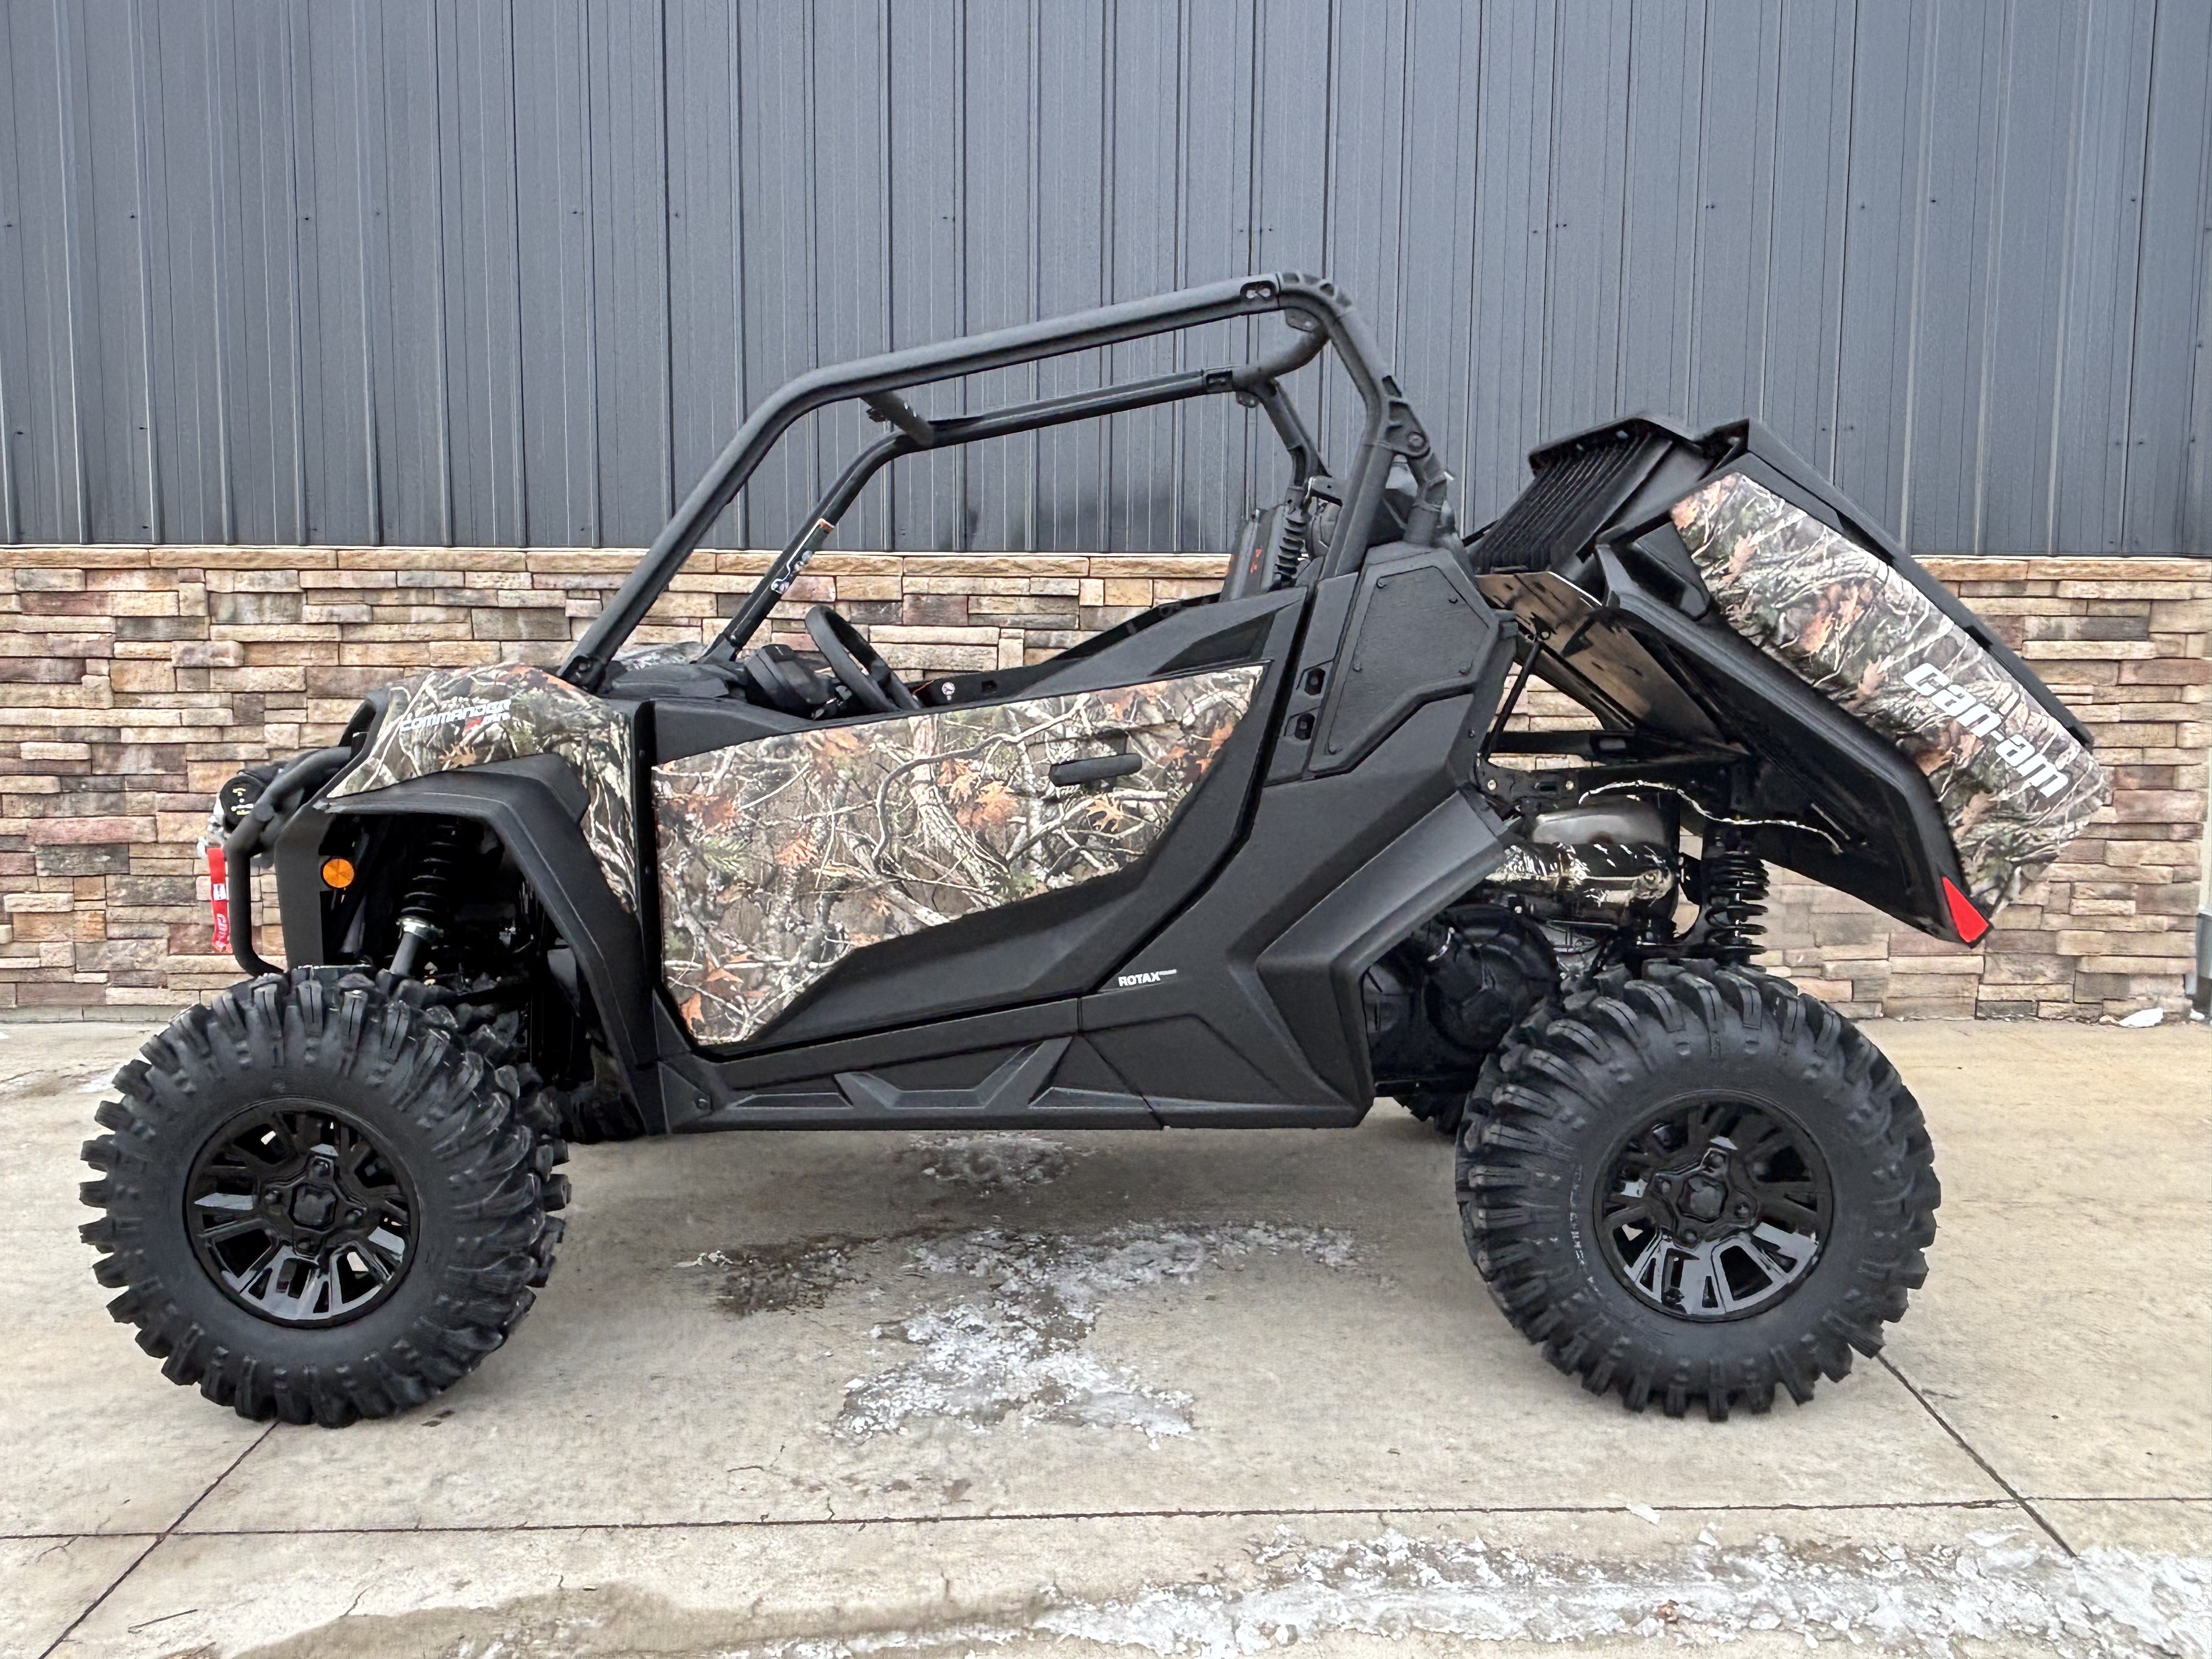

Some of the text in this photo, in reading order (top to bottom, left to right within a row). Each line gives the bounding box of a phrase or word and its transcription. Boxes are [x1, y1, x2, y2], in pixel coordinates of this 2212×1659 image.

[399, 698, 511, 732] COMMANDER
[1903, 662, 2069, 798] can-am
[1118, 971, 1161, 987] ROTAX
